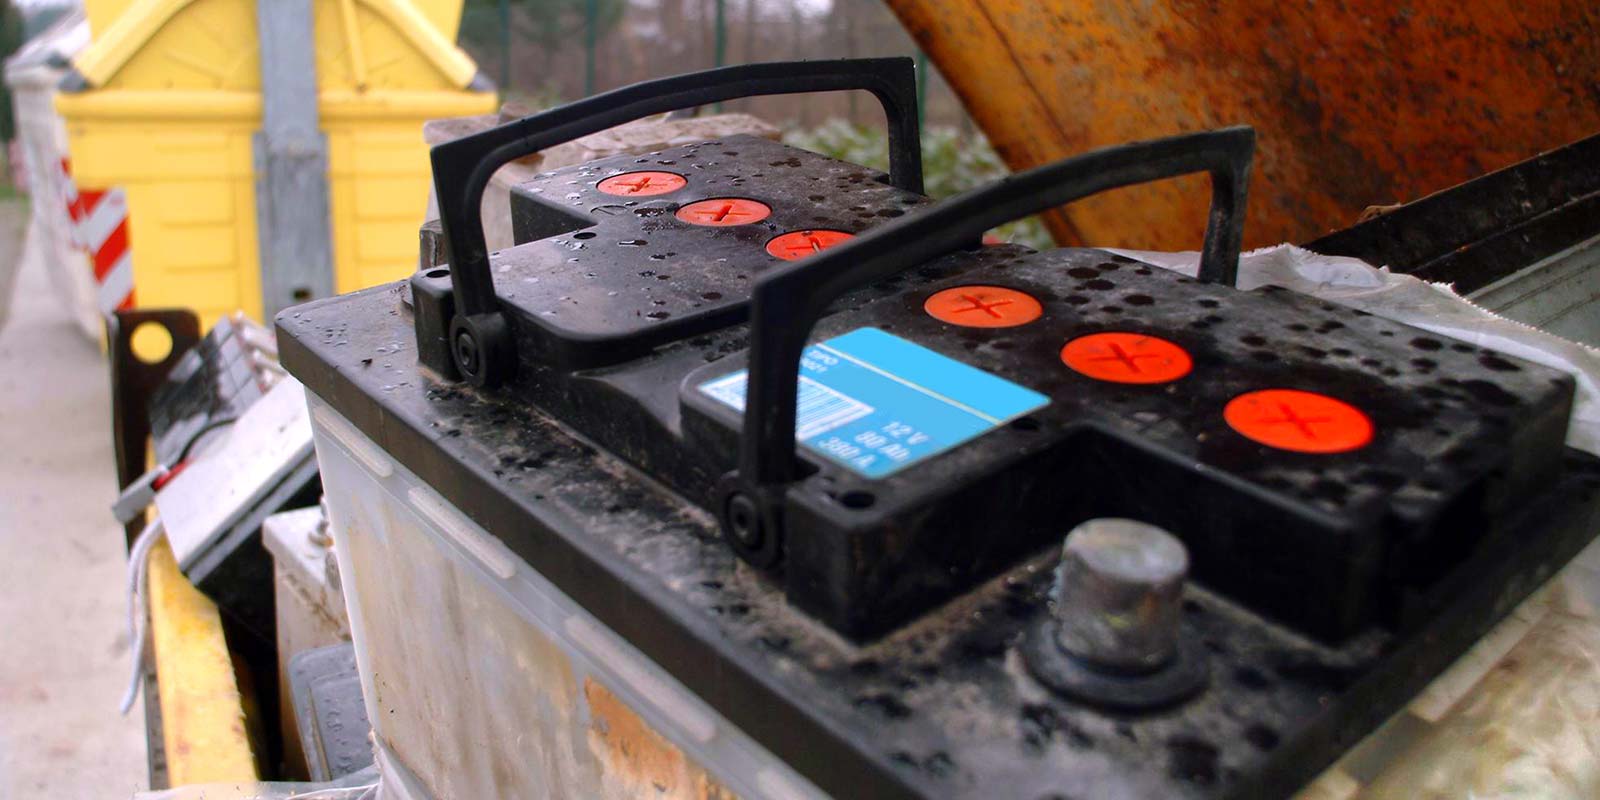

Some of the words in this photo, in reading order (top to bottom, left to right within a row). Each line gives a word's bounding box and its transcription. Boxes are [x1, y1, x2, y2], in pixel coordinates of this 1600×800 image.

[882, 421, 913, 438] 12
[907, 432, 931, 445] V
[851, 454, 876, 470] A
[878, 443, 912, 462] Ah
